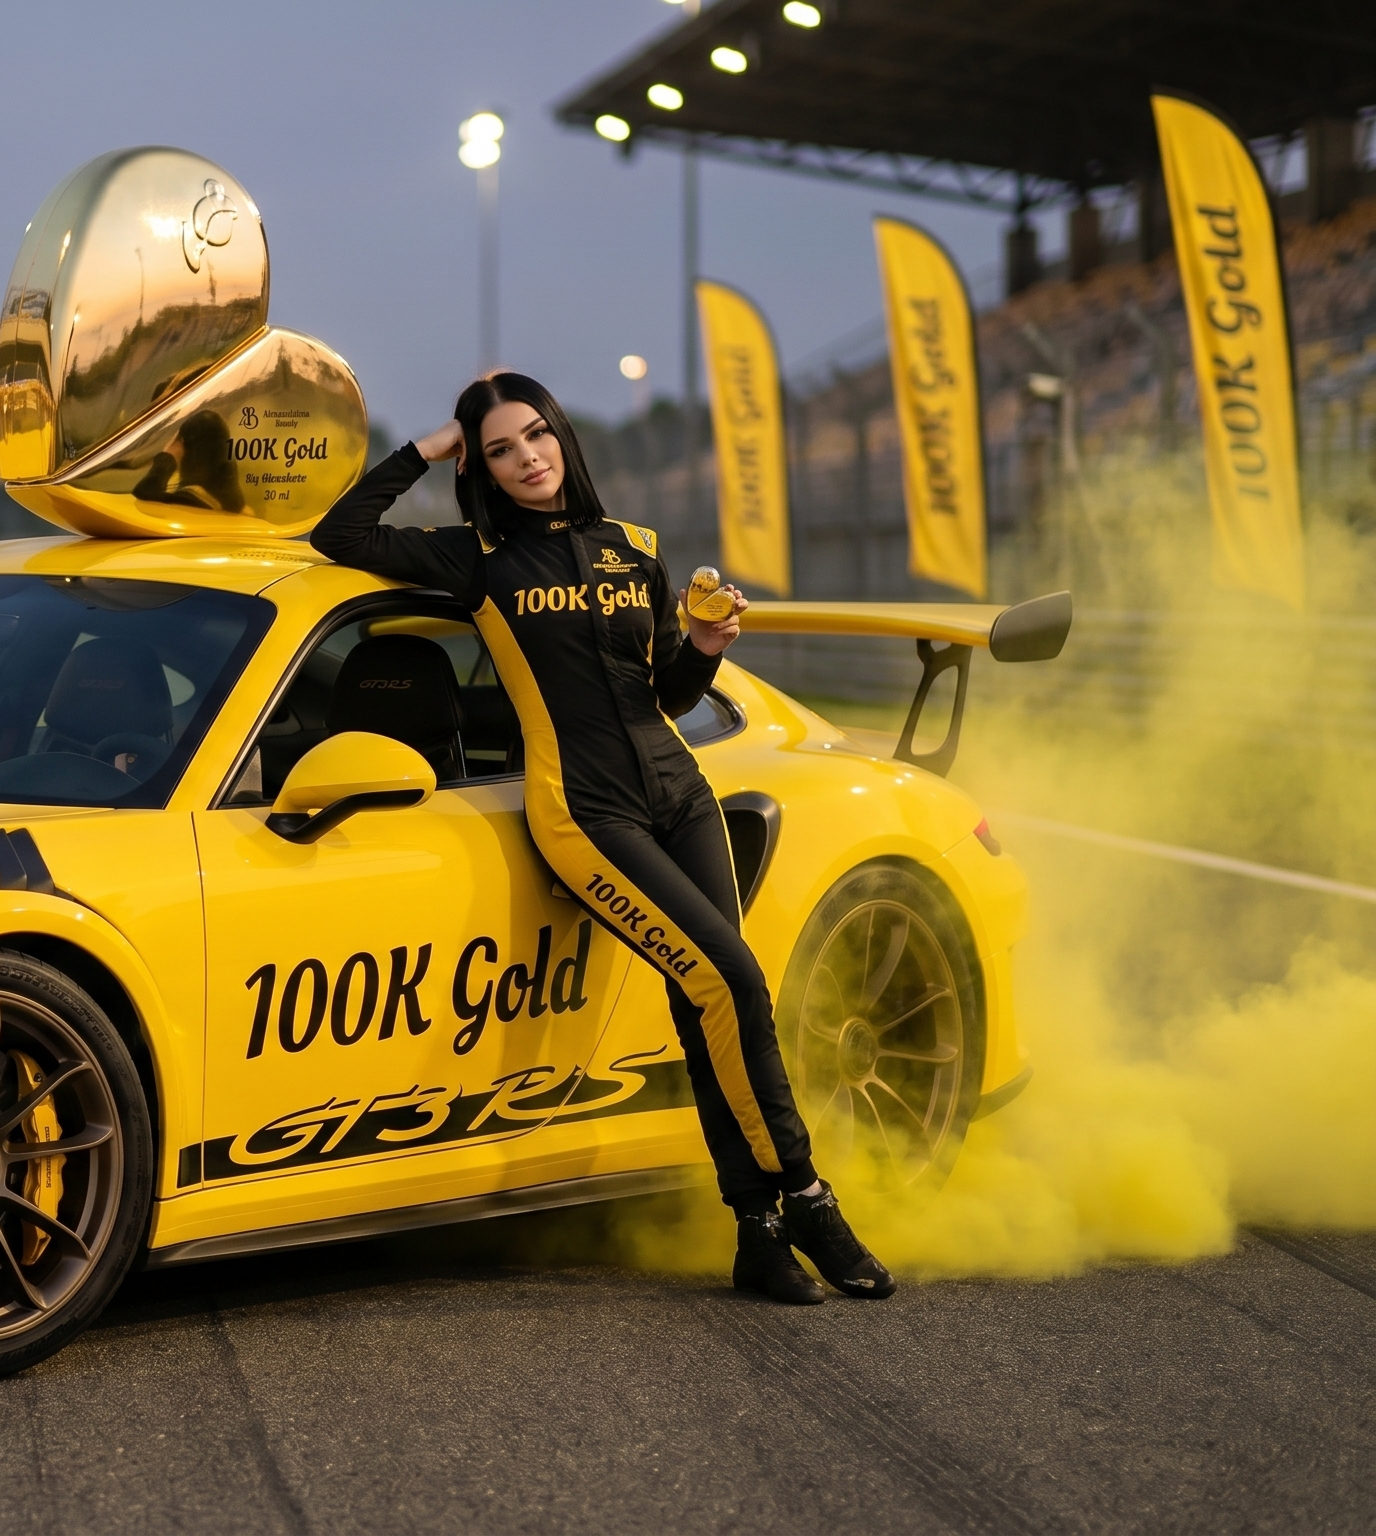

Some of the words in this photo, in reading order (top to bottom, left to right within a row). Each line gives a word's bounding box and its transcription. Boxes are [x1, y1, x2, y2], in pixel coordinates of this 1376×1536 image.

[1197, 204, 1262, 334] Gold
[226, 437, 279, 461] 100K
[284, 437, 328, 468] Gold
[1210, 354, 1271, 500] 100K
[264, 490, 277, 500] 30
[278, 489, 291, 500] ml
[514, 584, 589, 616] 100K
[596, 581, 650, 616] Gold
[585, 873, 649, 933] 100K
[640, 926, 699, 978] Gold
[244, 942, 433, 1061] 100K
[451, 918, 593, 1057] Gold
[229, 1083, 465, 1166] GT3
[466, 1044, 669, 1132] RS
